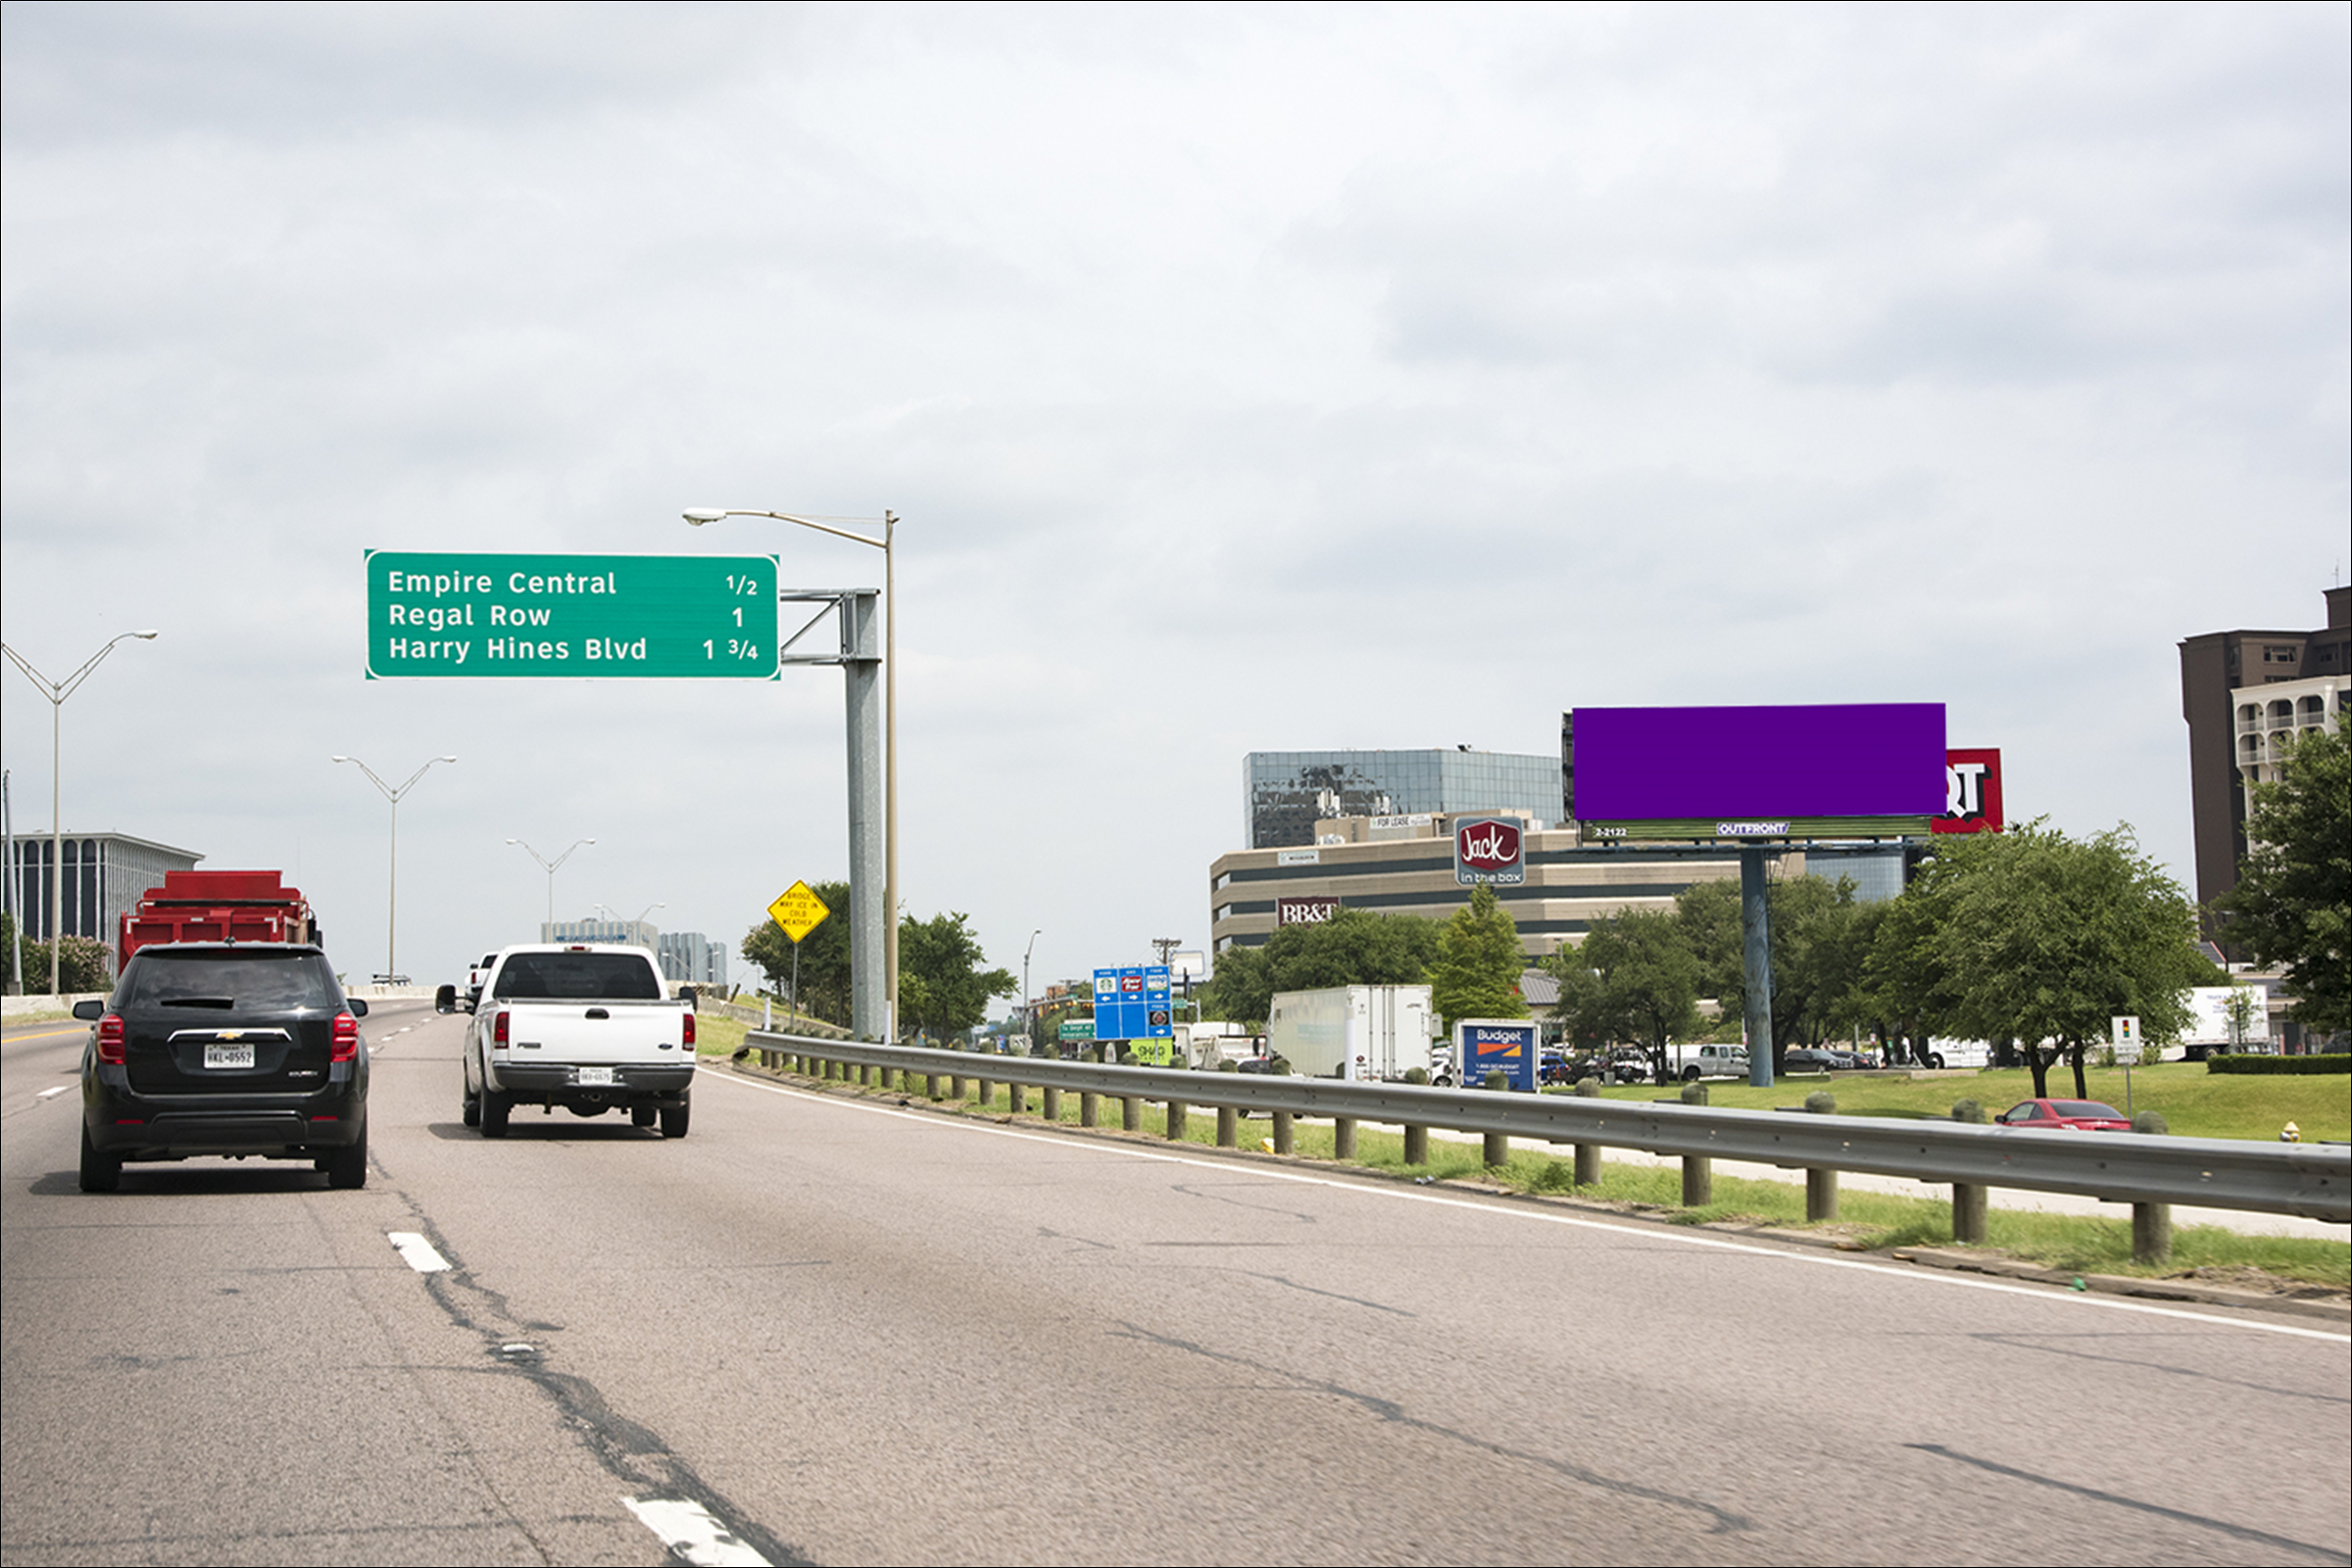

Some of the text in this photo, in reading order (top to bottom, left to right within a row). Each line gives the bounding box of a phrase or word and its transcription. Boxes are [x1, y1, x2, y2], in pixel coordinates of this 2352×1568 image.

[389, 571, 758, 598] Empire Central 1/2
[389, 605, 743, 631] Regal Row 1
[389, 637, 759, 663] Harry Hines Blvd 1 3/4
[1377, 817, 1390, 827] FOR
[1392, 816, 1409, 827] LEASE
[1462, 825, 1518, 861] Jack
[1475, 872, 1496, 883] the
[1497, 872, 1522, 882] box
[789, 909, 808, 918] COLD
[797, 901, 808, 909] ICE
[1281, 903, 1338, 923] BB&T
[1477, 1029, 1522, 1044] Budget
